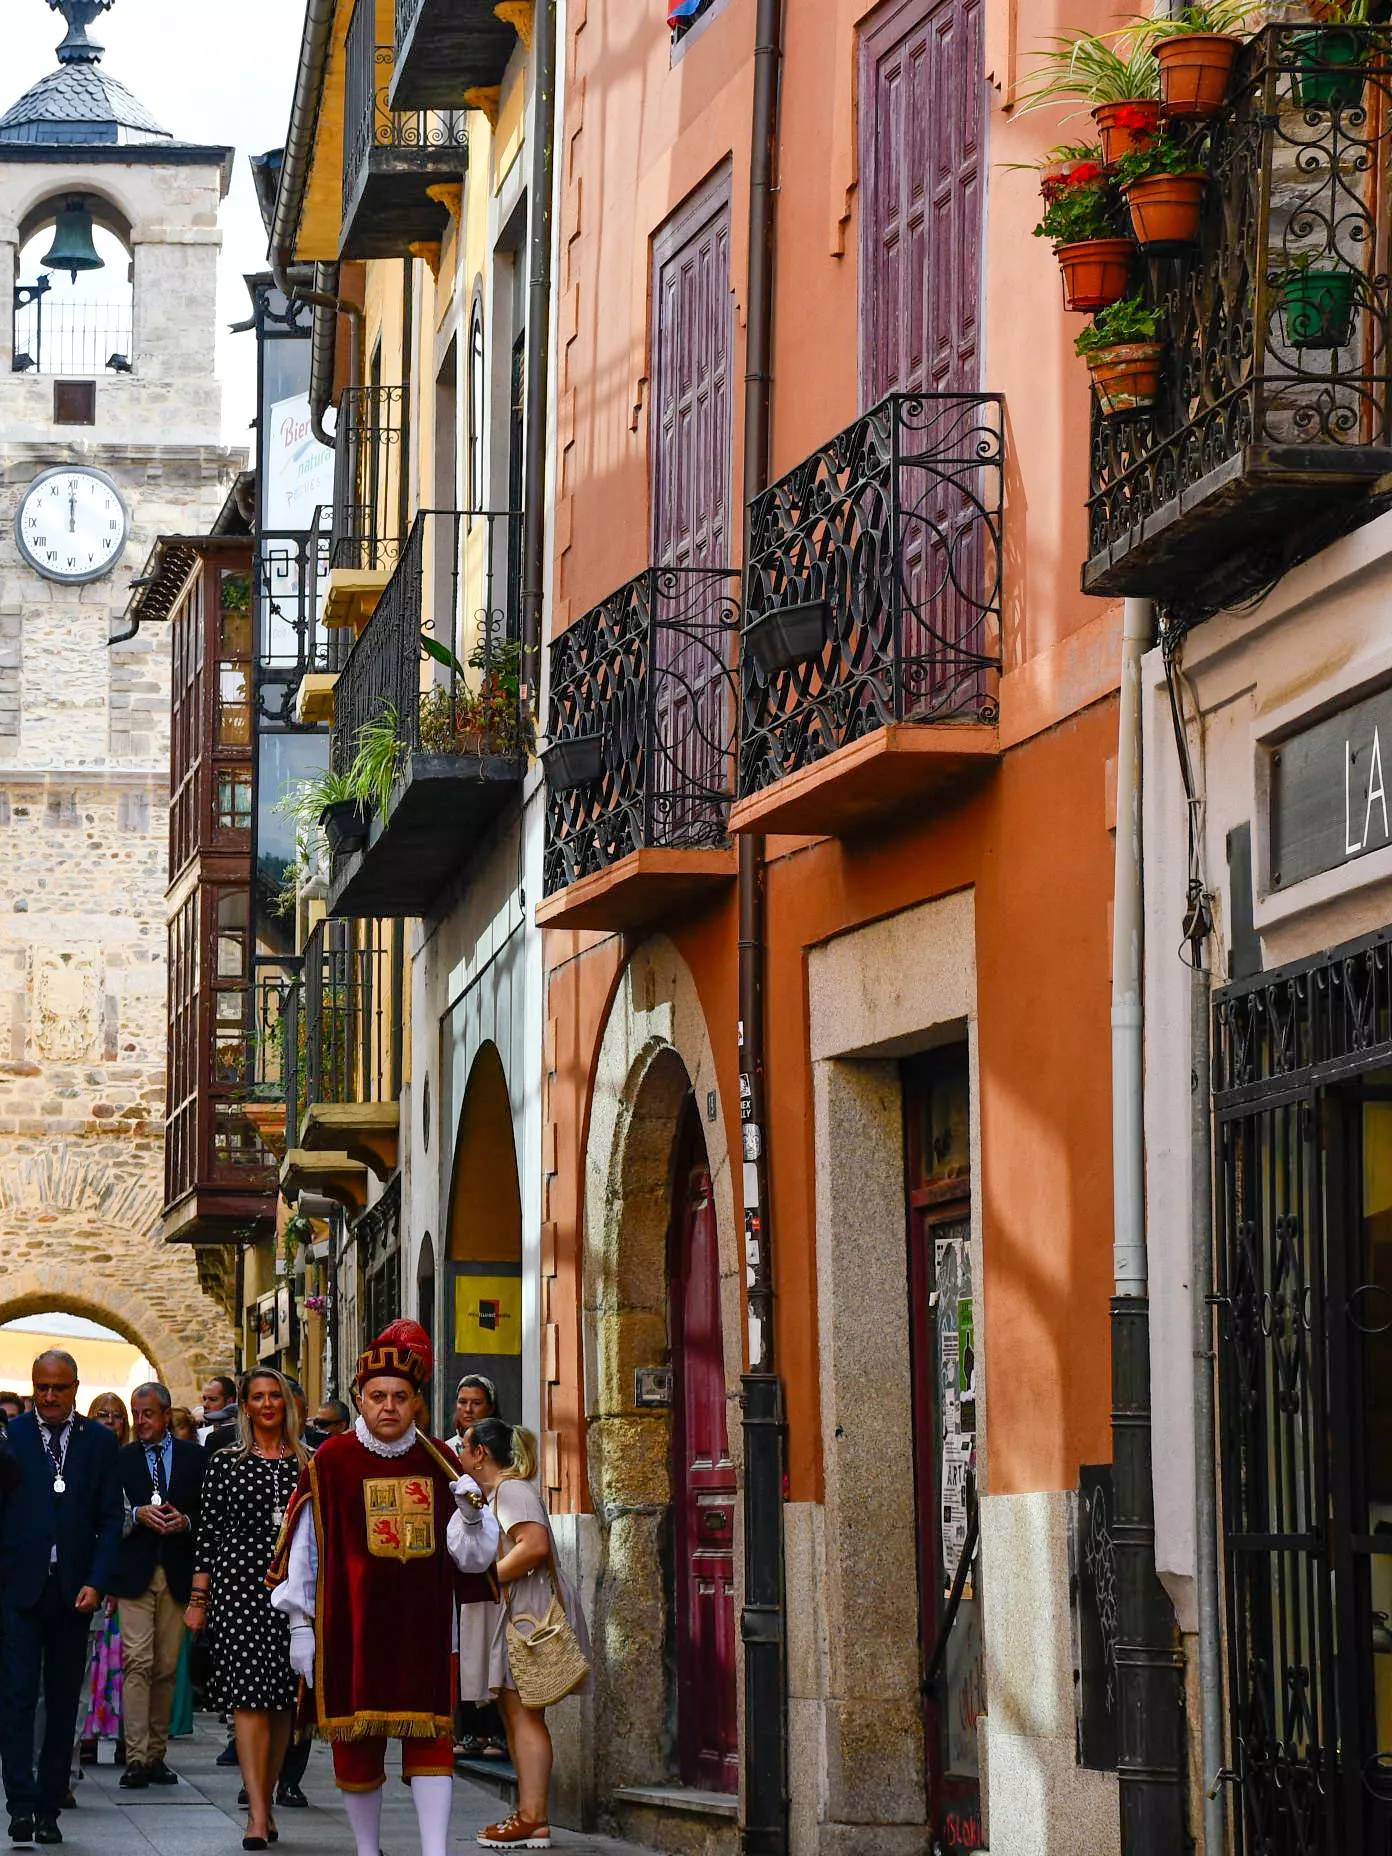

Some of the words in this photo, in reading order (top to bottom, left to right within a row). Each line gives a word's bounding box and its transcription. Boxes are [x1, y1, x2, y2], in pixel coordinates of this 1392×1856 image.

[51, 486, 59, 496] XI
[36, 498, 42, 508] X
[105, 500, 110, 509] II
[28, 517, 38, 528] IX
[33, 536, 47, 547] VIII
[102, 538, 112, 548] IV
[46, 550, 58, 561] VII
[88, 553, 94, 562] V
[67, 557, 76, 567] VI
[1345, 725, 1389, 855] LA
